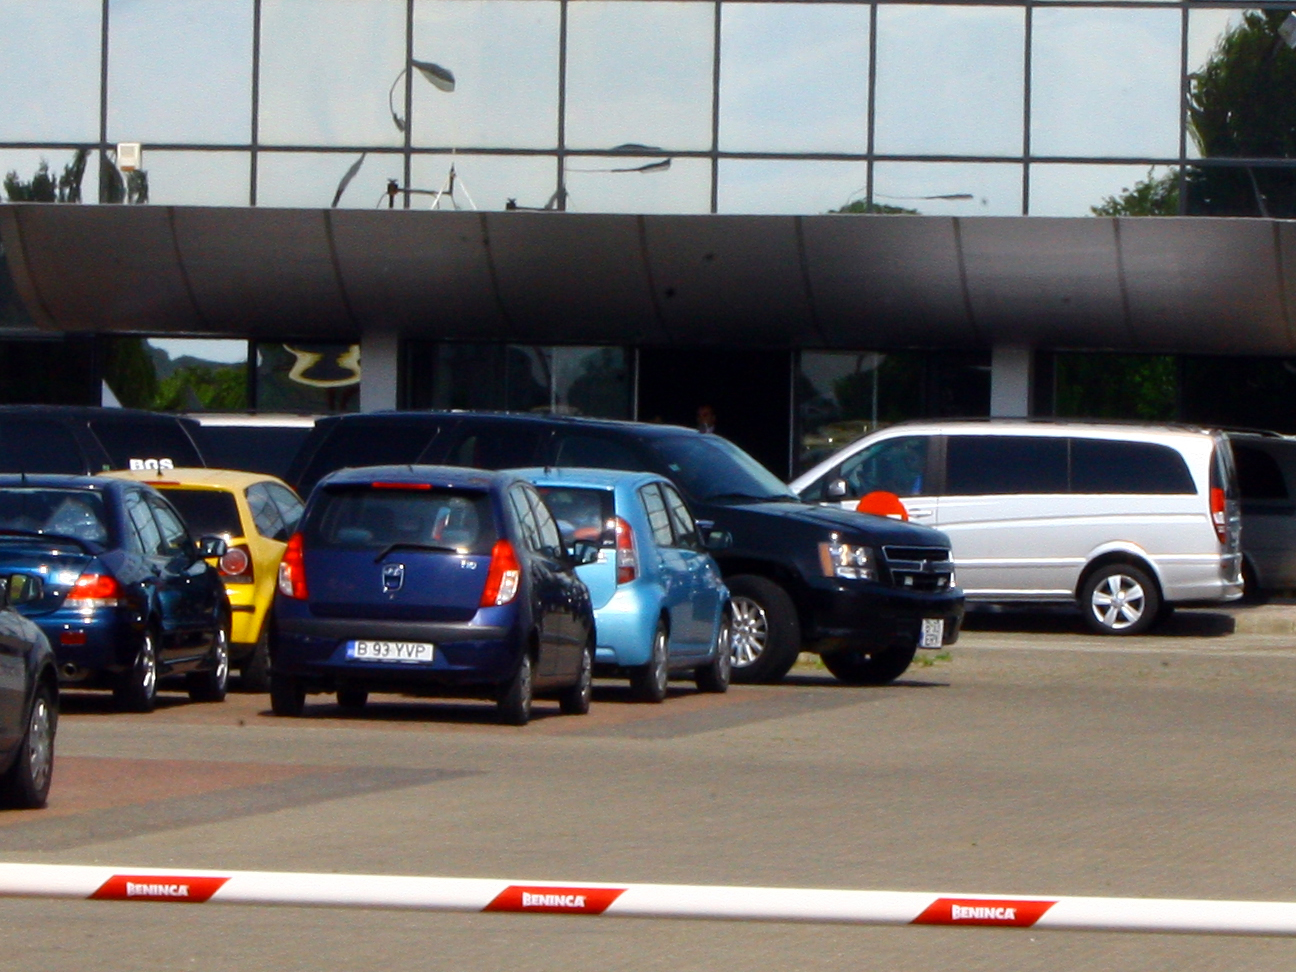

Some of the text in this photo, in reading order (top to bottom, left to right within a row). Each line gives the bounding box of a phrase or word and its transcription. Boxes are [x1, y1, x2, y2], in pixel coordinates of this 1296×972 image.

[357, 642, 426, 658] B 93 YVP
